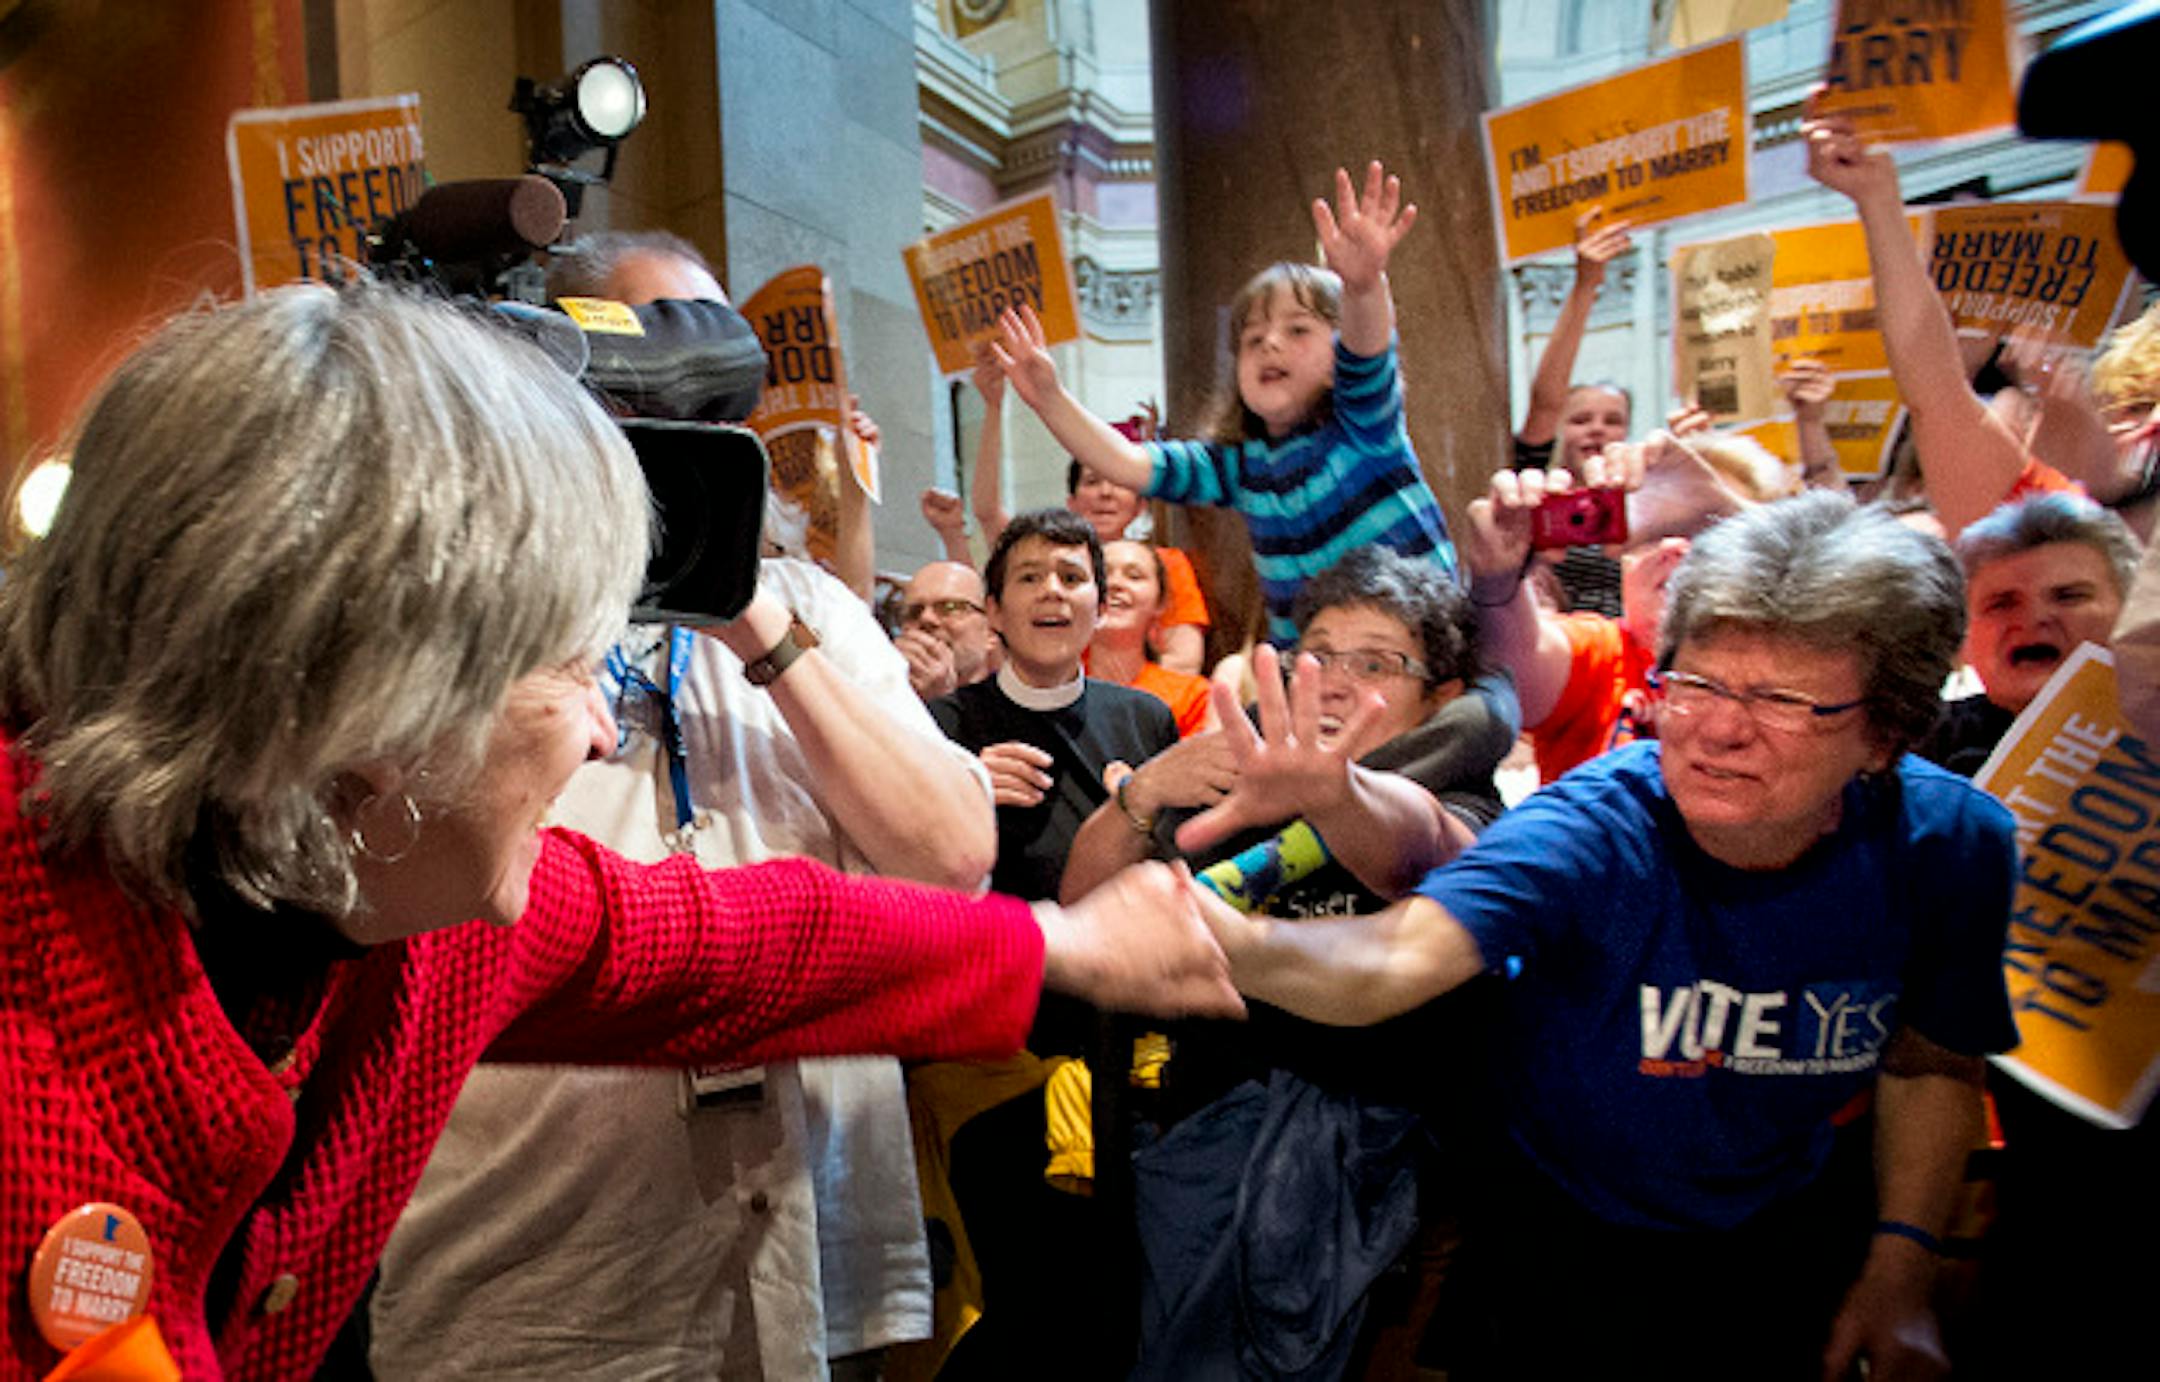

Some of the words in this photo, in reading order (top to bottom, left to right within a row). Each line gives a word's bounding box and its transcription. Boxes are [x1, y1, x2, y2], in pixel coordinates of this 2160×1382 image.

[276, 137, 291, 181] I
[297, 125, 408, 177] SUPPORT
[1512, 172, 1609, 219] FREEDOM
[1615, 162, 1645, 191] TO
[1648, 138, 1731, 181] MARRY
[923, 240, 1043, 308] FREEDOM
[1927, 257, 2097, 307] FREEDO
[2055, 235, 2099, 270] TO
[2025, 711, 2119, 789] THE
[1803, 986, 1898, 1060] YES
[2023, 960, 2109, 1031] TO
[50, 1285, 74, 1313] TO
[75, 1291, 136, 1324] MARRY
[53, 1256, 142, 1299] FREEDOM
